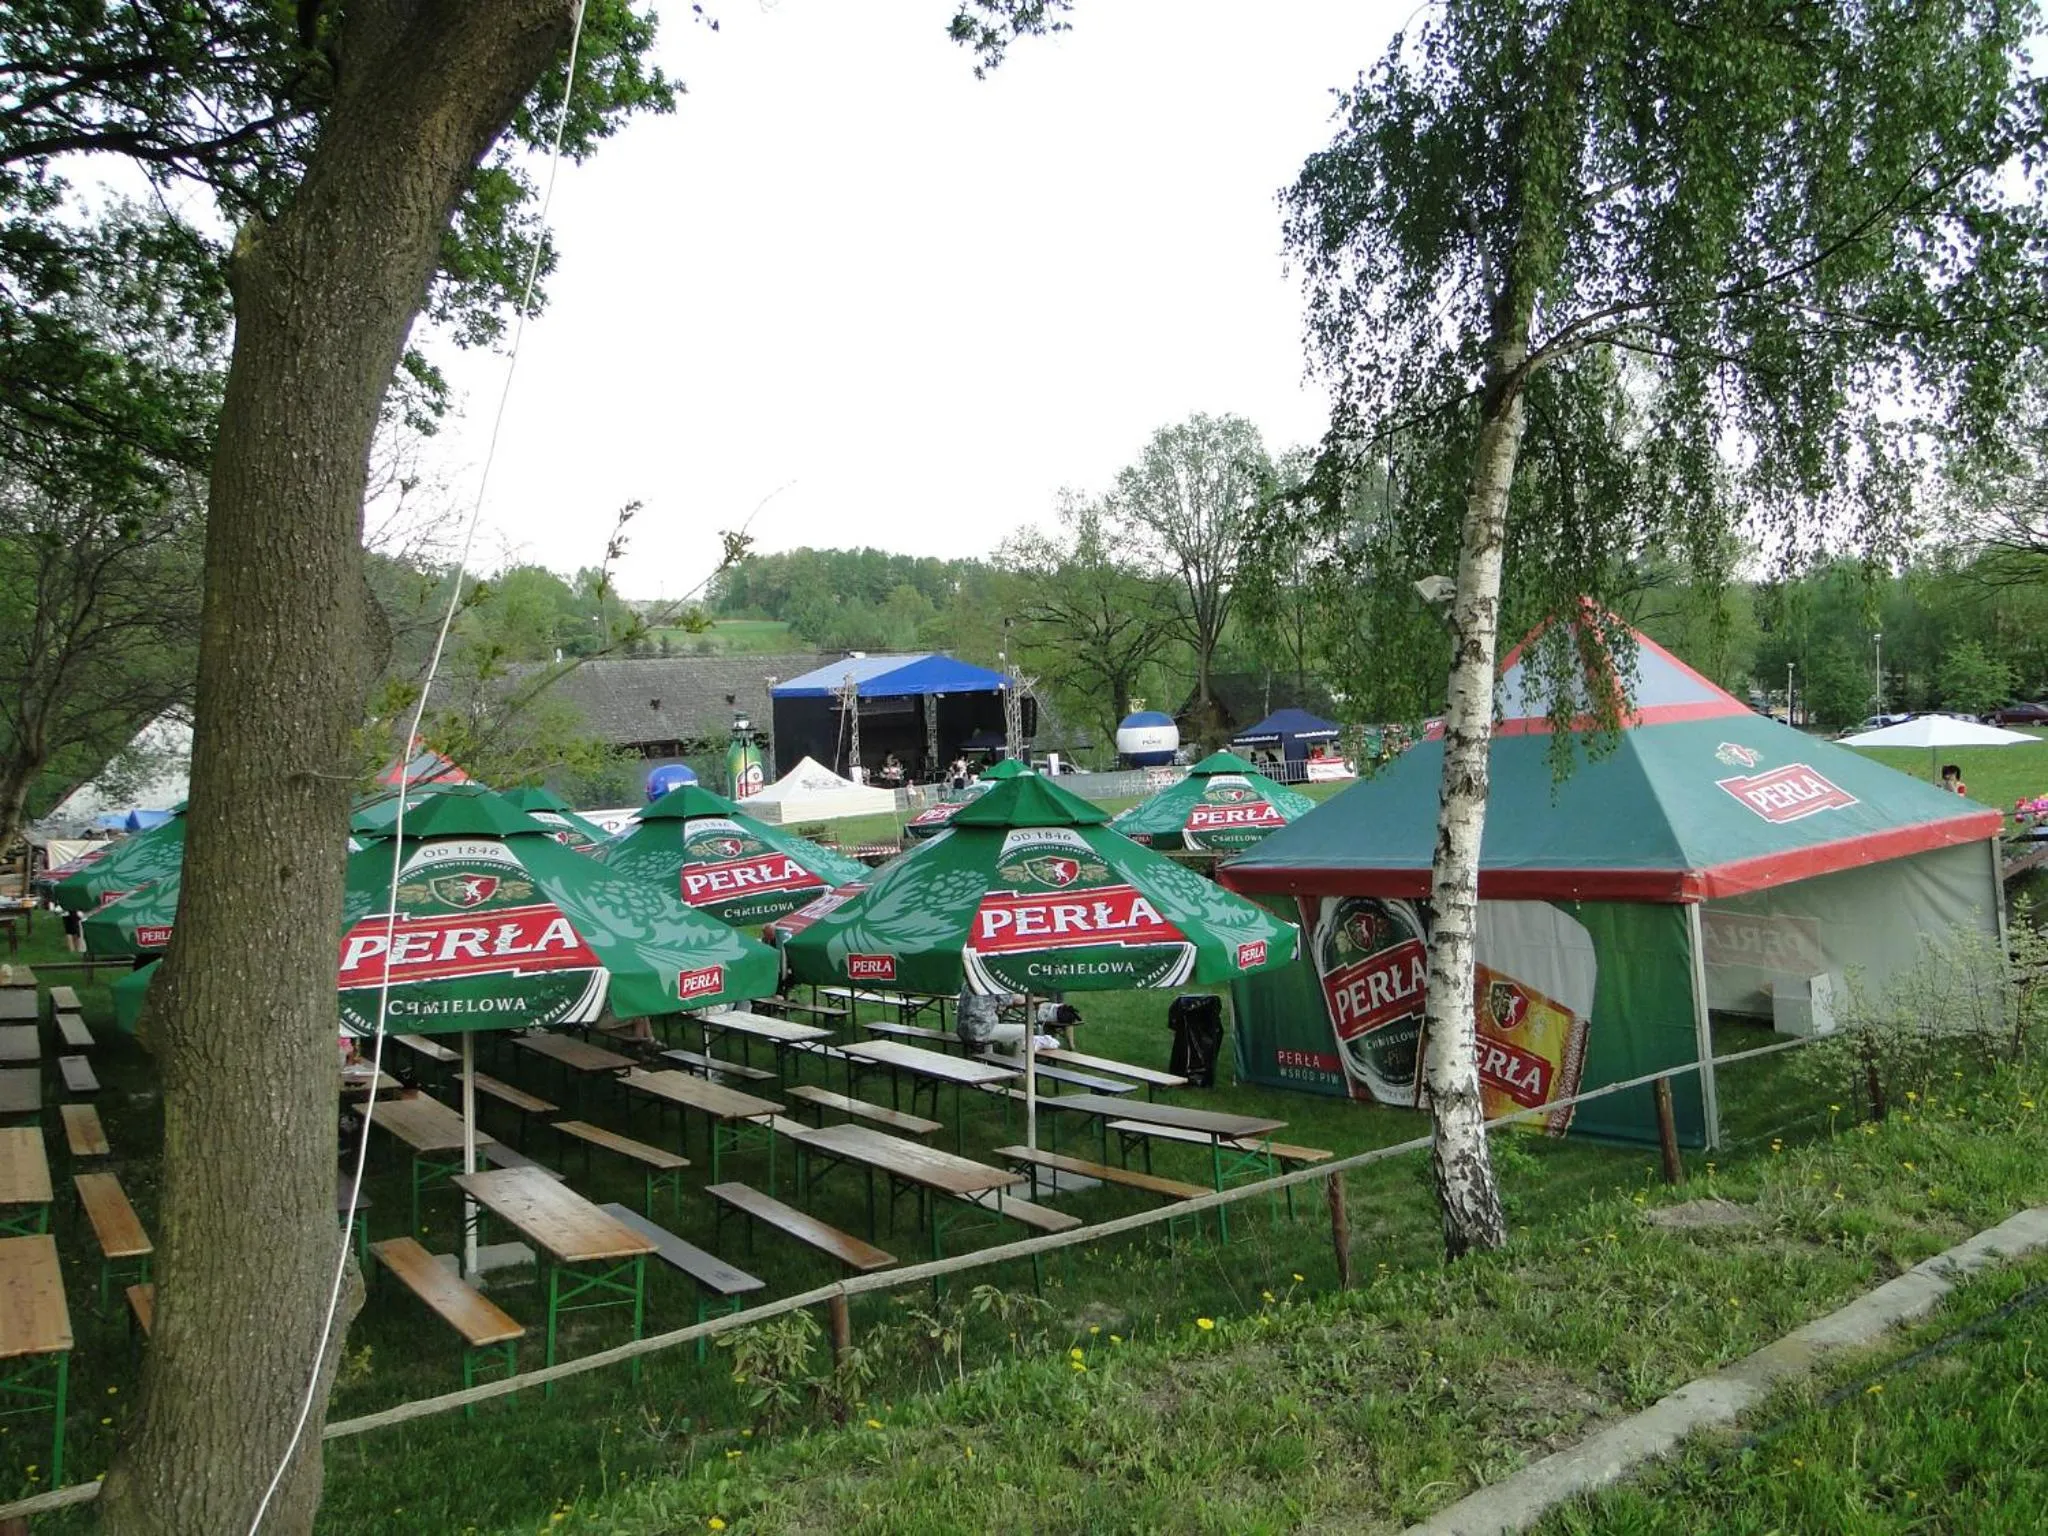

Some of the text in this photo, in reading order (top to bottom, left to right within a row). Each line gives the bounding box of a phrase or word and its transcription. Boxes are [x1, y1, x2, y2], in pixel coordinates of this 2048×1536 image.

[1745, 774, 1833, 812] PERŁA
[1191, 806, 1280, 825] PERŁA
[1011, 831, 1071, 842] OD 1846
[423, 846, 499, 857] OD 1846
[684, 859, 808, 895] PERŁA
[724, 901, 795, 918] CHMIELOWA
[979, 898, 1164, 938] PERŁA
[340, 918, 578, 970] PERŁA
[852, 960, 892, 973] PERŁA
[1028, 962, 1135, 976] CHMIELOWA
[684, 971, 720, 993] PERŁA
[1335, 956, 1428, 1024] PERŁA
[388, 997, 528, 1016] CHMIELOWA
[1278, 1050, 1320, 1068] PERŁA
[1475, 1041, 1541, 1095] ERŁA
